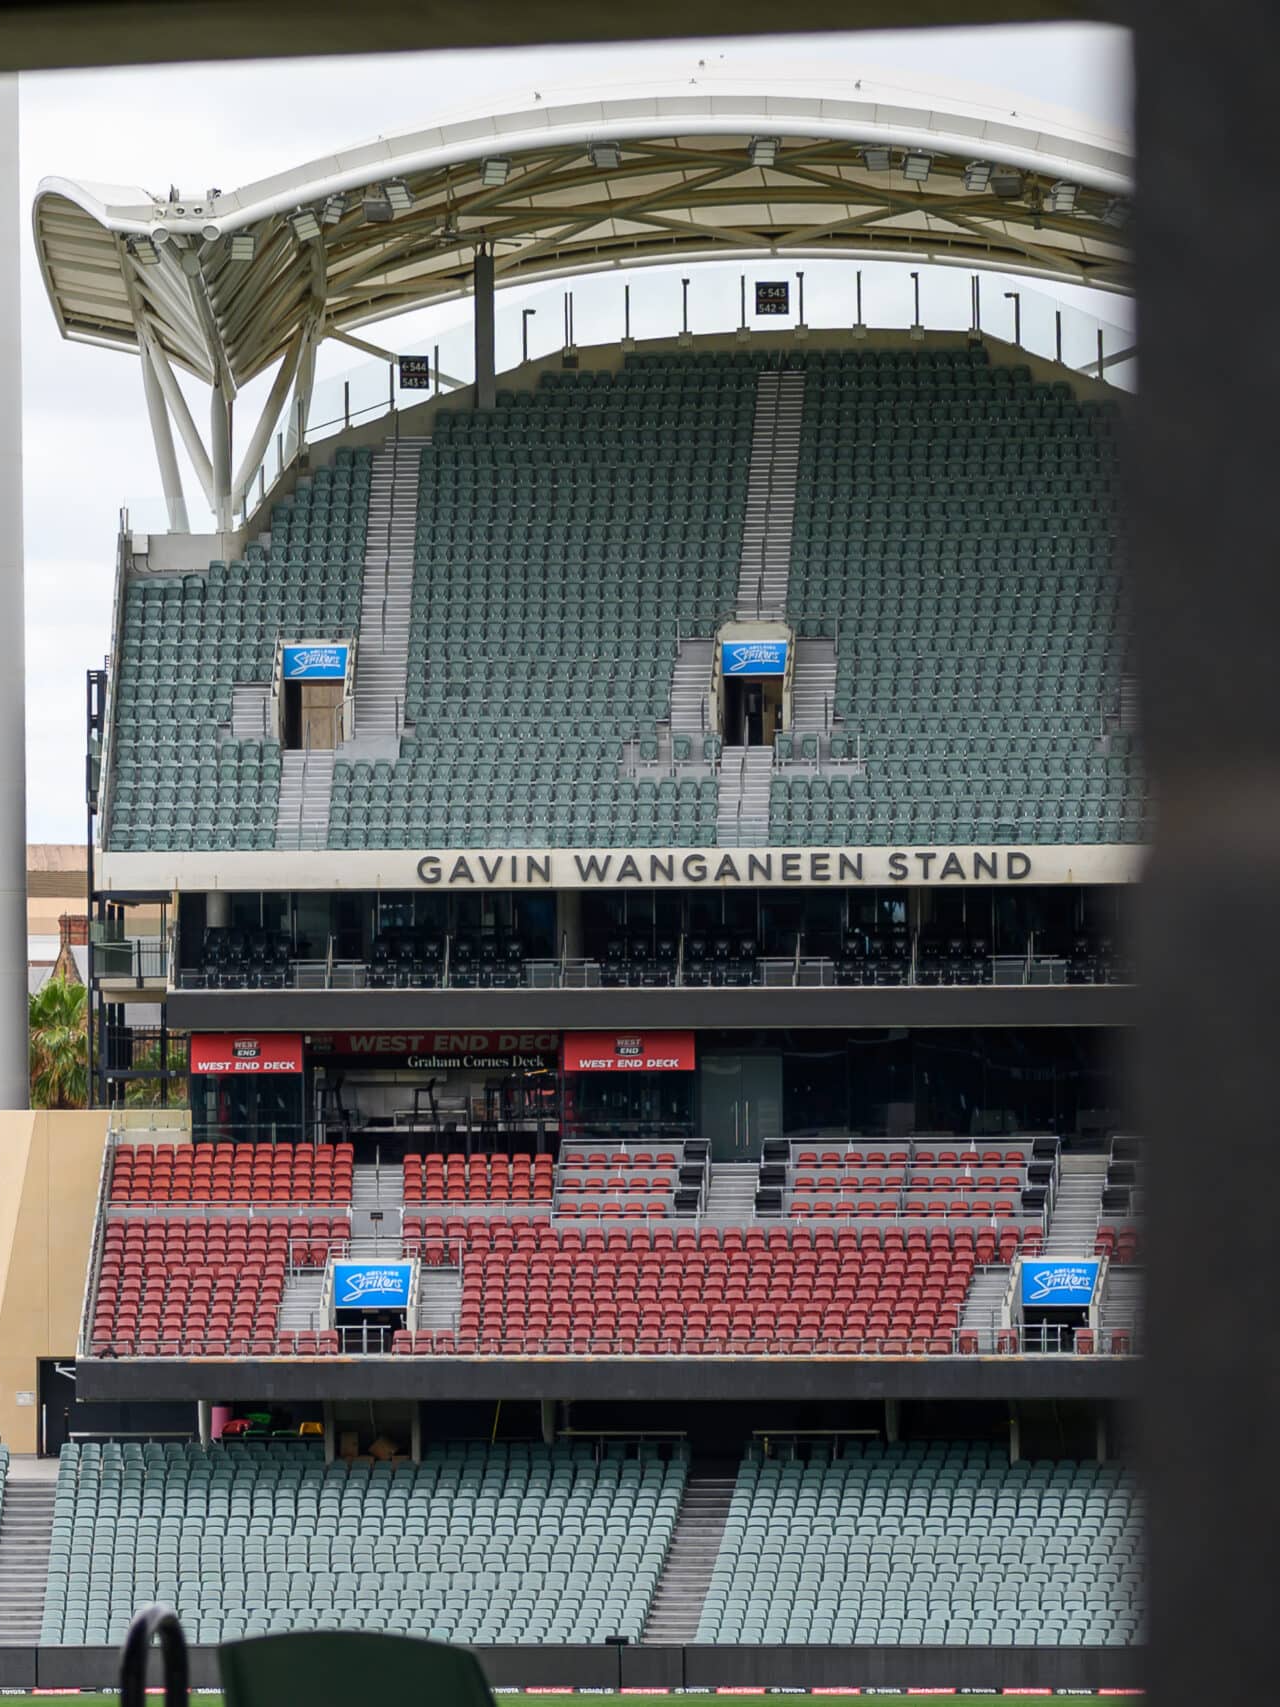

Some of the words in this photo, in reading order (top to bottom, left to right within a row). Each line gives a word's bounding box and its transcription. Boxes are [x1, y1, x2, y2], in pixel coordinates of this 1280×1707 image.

[767, 287, 786, 298] 543
[759, 303, 777, 313] 542
[410, 361, 427, 372] 544
[416, 855, 551, 884] GAVIN
[573, 852, 863, 882] WANGANEEN
[888, 851, 1032, 880] STAND
[348, 1035, 424, 1052] WEST
[432, 1034, 489, 1051] END
[197, 1061, 232, 1071] WEST
[234, 1061, 260, 1070] END
[263, 1060, 295, 1070] DECK
[407, 1055, 461, 1069] Graham
[463, 1055, 510, 1068] Cornes
[512, 1054, 545, 1067] Deck
[579, 1059, 613, 1068] WEST
[617, 1059, 643, 1068] END
[646, 1058, 679, 1067] DECK
[342, 1272, 404, 1302] Strikers
[1029, 1269, 1092, 1300] Strikers
